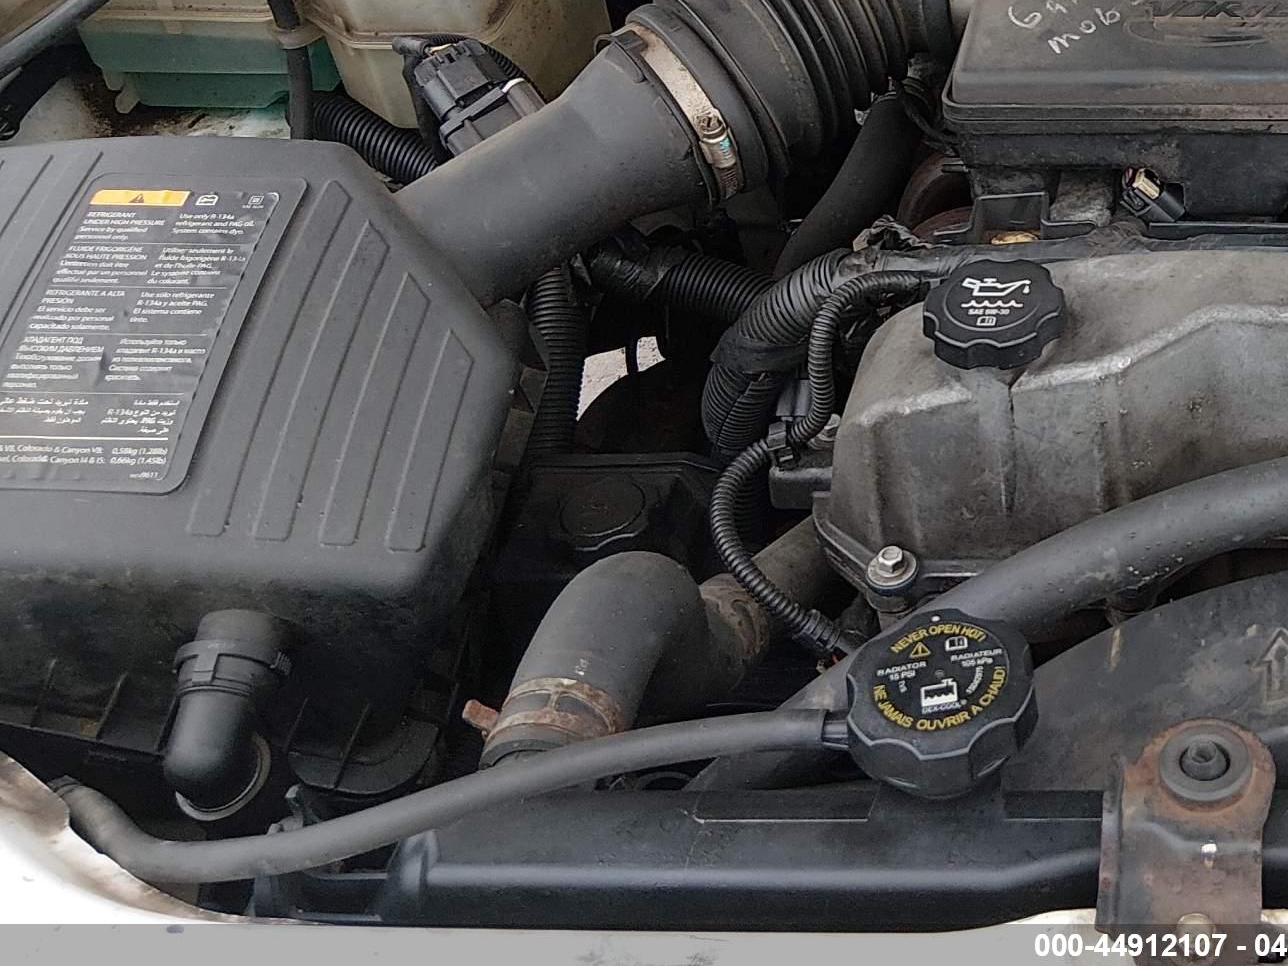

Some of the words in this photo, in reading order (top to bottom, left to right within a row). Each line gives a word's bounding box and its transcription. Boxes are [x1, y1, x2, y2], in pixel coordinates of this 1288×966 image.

[891, 628, 929, 653] NEVER
[929, 624, 961, 635] OPEN
[961, 626, 987, 643] HOT!
[951, 649, 1003, 662] RADIATEUR
[877, 661, 927, 676] RADIATOR
[901, 670, 916, 679] PSI
[874, 684, 887, 701] NE
[979, 666, 1006, 707] CHAUD!
[878, 698, 914, 728] JAMAIS
[916, 711, 971, 730] OUVRIR
